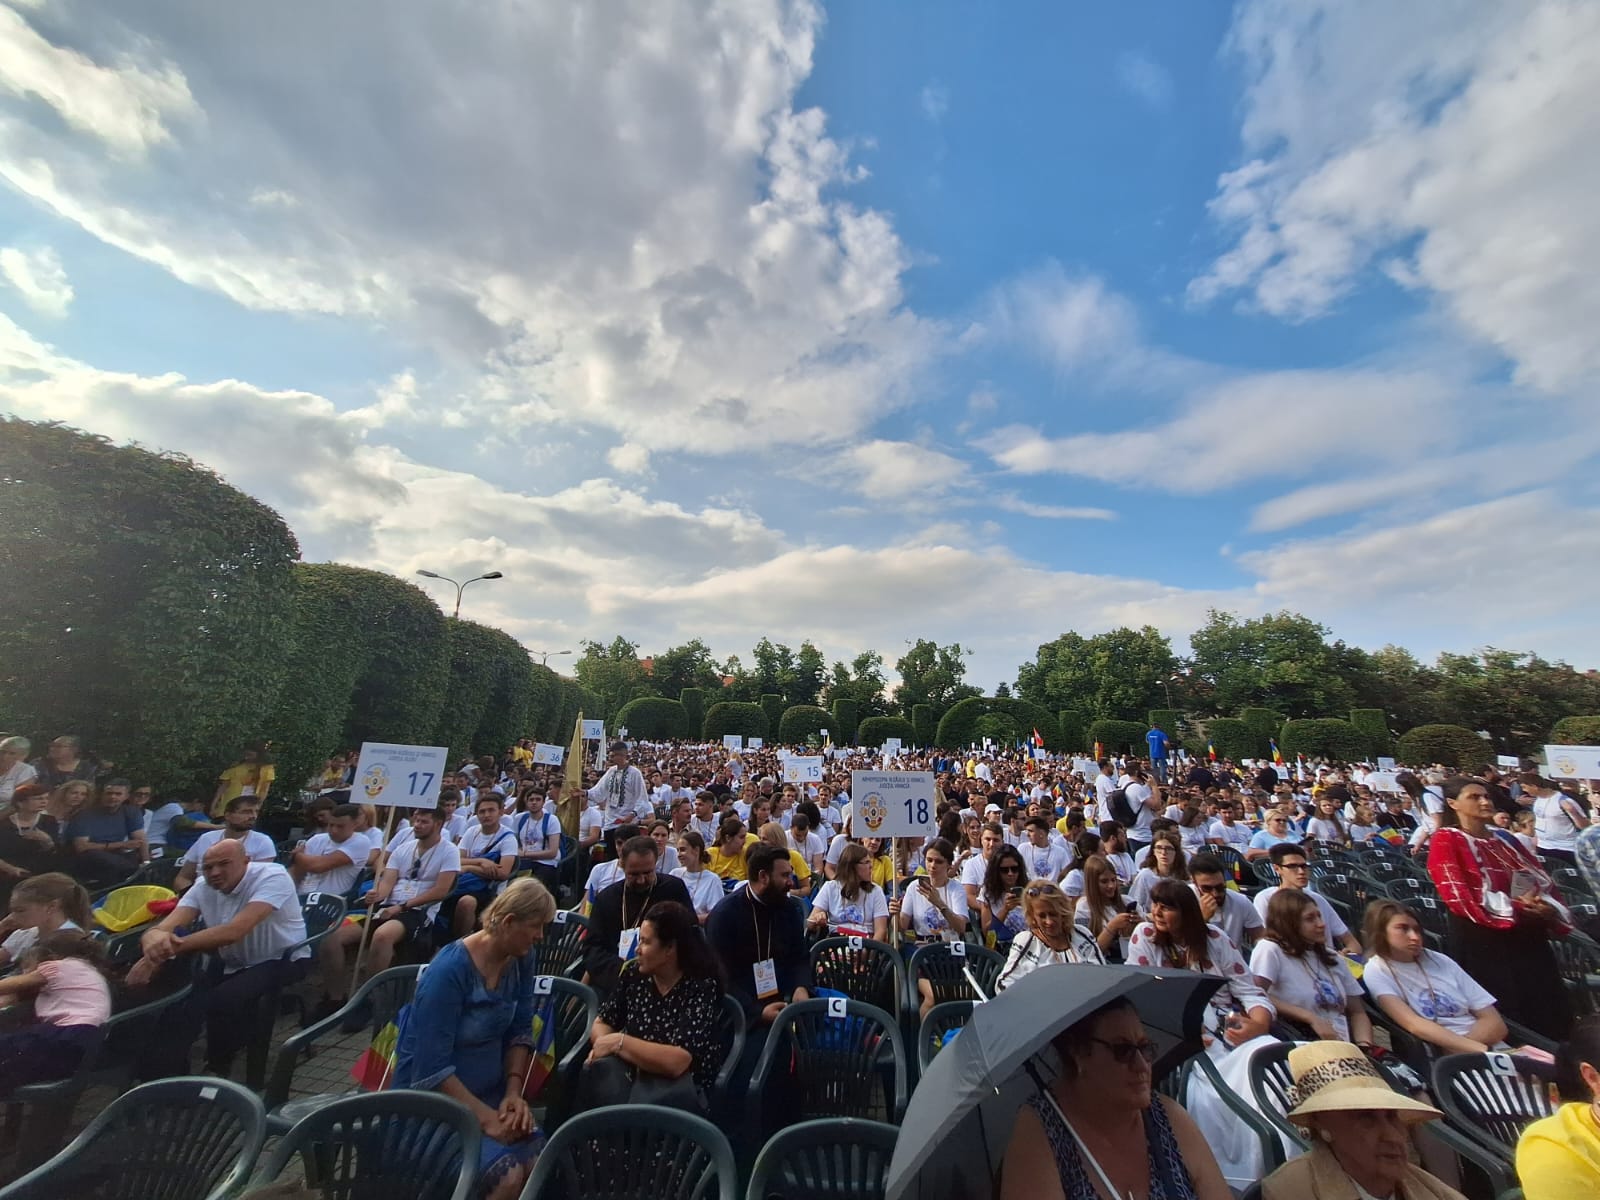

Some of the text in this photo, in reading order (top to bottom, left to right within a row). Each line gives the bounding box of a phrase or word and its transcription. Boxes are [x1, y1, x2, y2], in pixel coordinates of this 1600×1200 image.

[591, 728, 600, 736] 36
[550, 753, 560, 762] 36
[807, 766, 819, 777] 15
[408, 771, 435, 796] 17
[904, 798, 929, 825] 18
[310, 894, 318, 902] C
[557, 912, 564, 921] C
[852, 937, 858, 946] C
[954, 943, 961, 952] C
[538, 978, 548, 990] C
[832, 1000, 842, 1013] C
[1494, 1055, 1508, 1071] C
